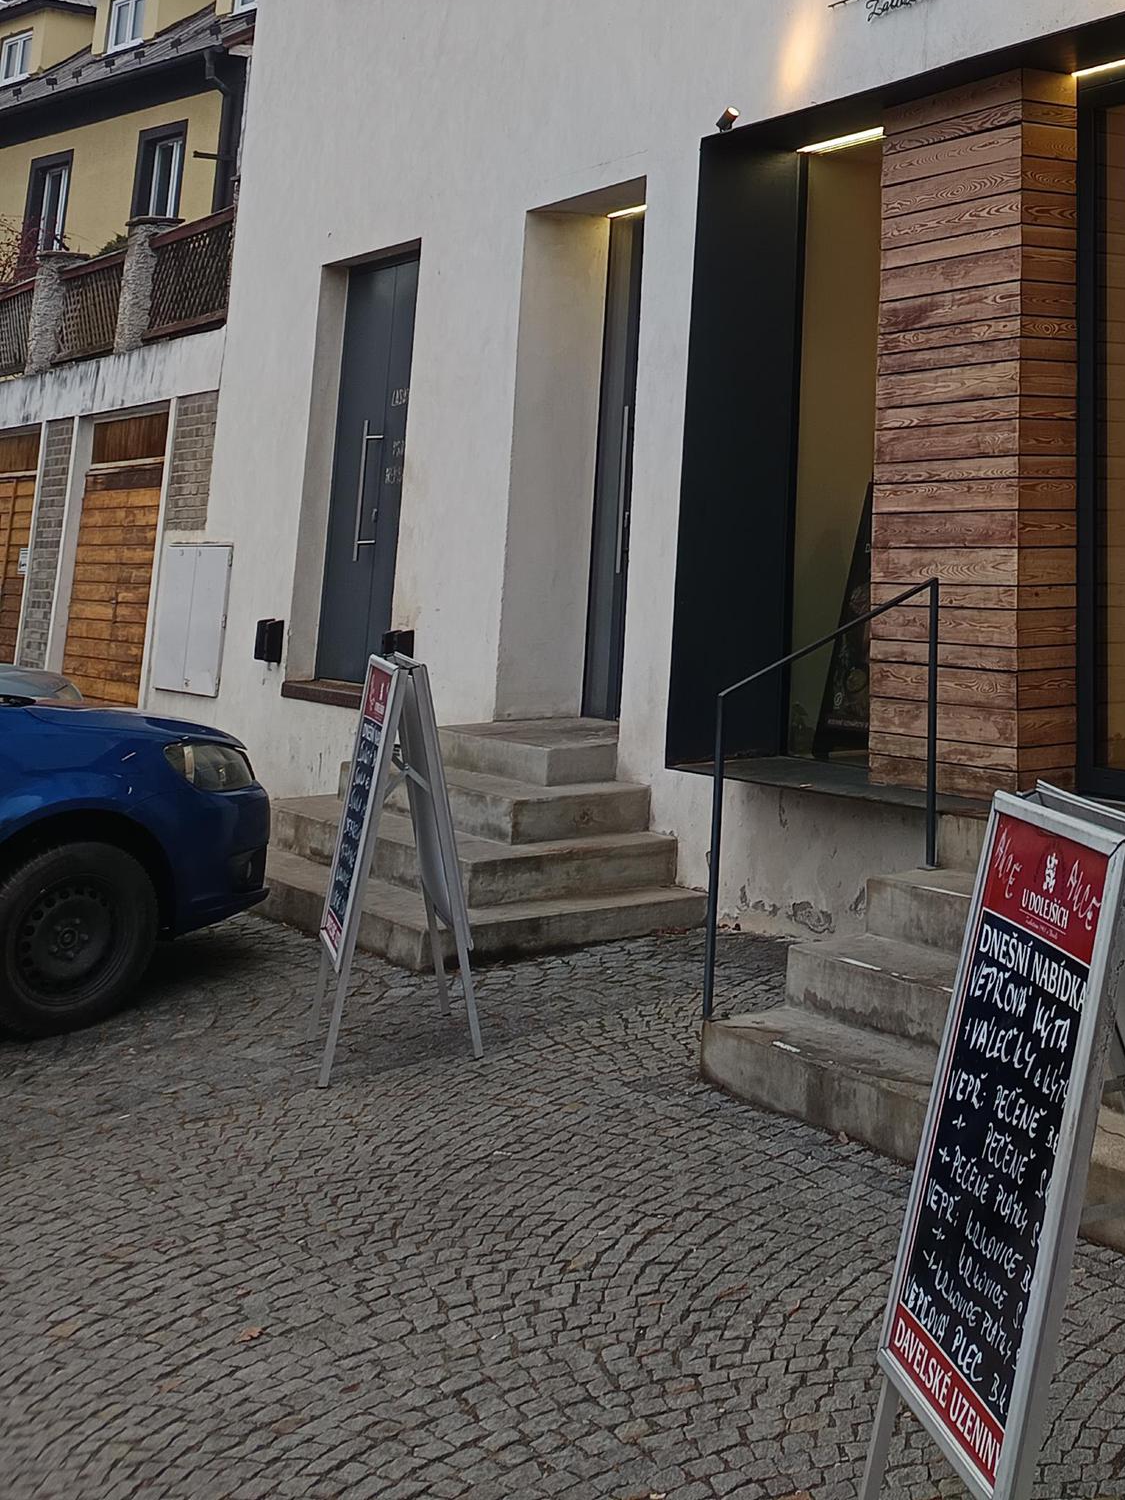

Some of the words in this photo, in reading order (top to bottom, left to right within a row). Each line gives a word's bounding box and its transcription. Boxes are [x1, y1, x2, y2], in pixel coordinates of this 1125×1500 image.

[1022, 888, 1030, 908] U
[1029, 891, 1069, 930] DOLEJŠÍCH
[969, 959, 1033, 1017] VEPŘOVÁ
[979, 922, 1034, 977] DNEŠNÍ
[1032, 953, 1087, 1013] NABÍDKA
[893, 1318, 951, 1409] DAVELSKÉ
[949, 1385, 1002, 1478] UZENINY
